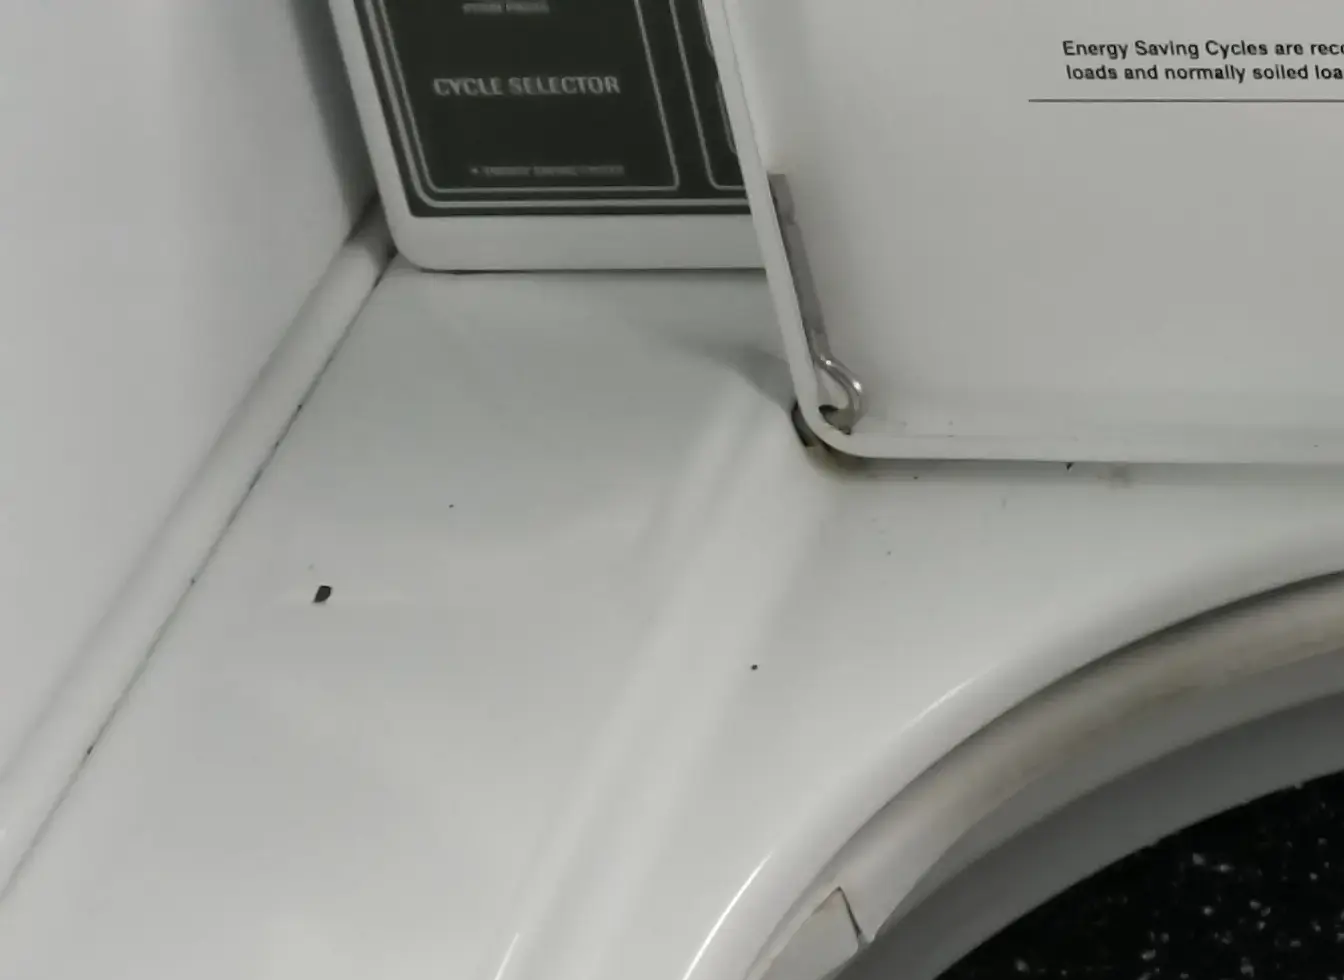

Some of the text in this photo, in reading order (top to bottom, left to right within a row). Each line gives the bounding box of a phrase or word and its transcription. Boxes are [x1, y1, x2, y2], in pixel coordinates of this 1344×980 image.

[1062, 39, 1129, 61] Energy
[1134, 39, 1200, 61] Saving
[1204, 39, 1269, 61] Cycles
[1274, 43, 1304, 57] are
[1065, 64, 1119, 81] loads
[1123, 64, 1159, 81] and
[1163, 63, 1246, 84] normally
[1251, 63, 1309, 81] soiled
[433, 75, 621, 96] CYCLE SELECTOR
